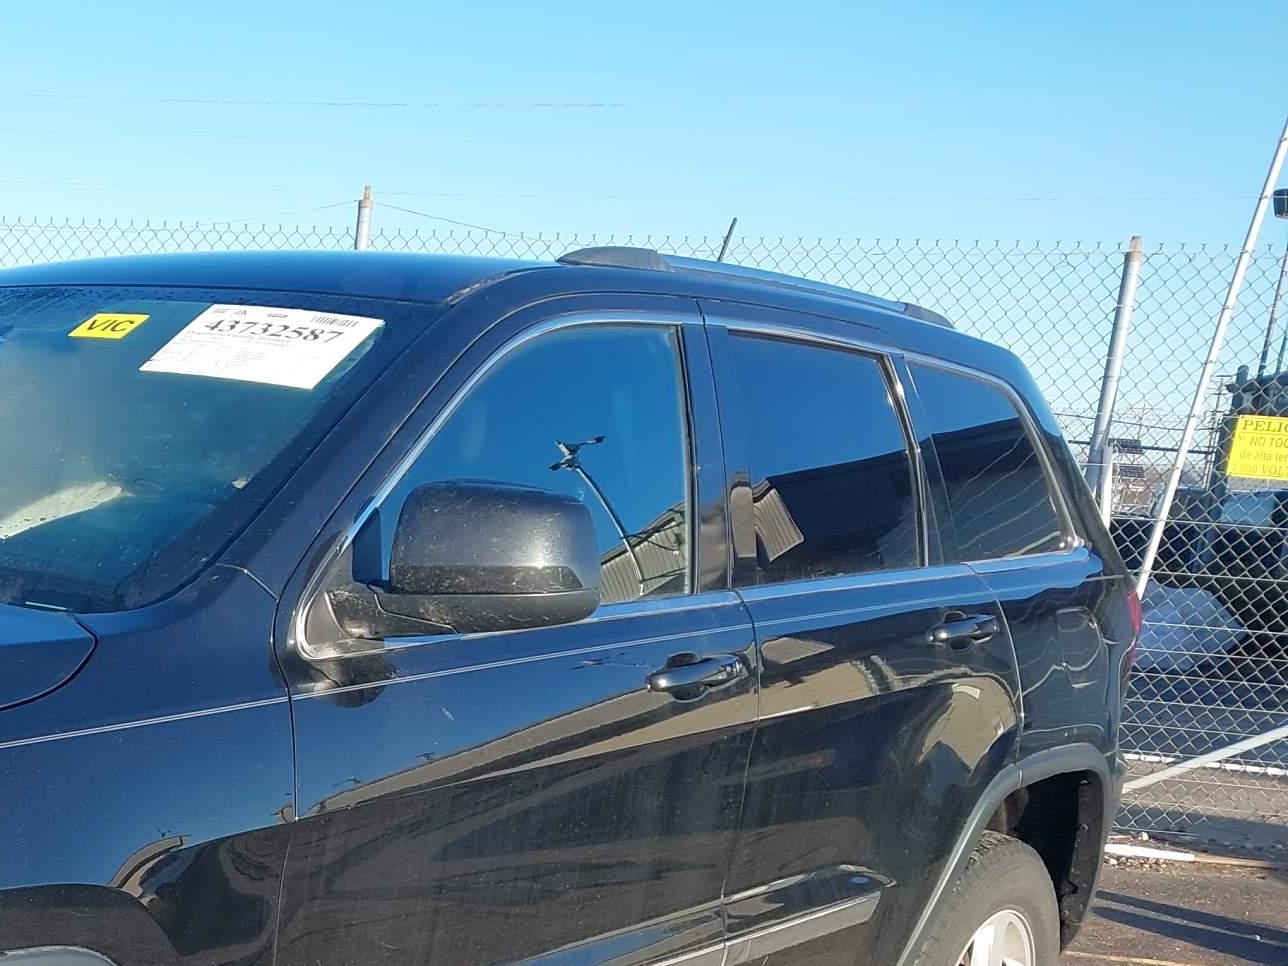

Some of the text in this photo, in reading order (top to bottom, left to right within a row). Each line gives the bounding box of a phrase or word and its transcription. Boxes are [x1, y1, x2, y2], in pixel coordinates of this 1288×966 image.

[86, 319, 135, 332] VIC
[204, 319, 345, 343] 43732587
[1249, 436, 1266, 447] NO
